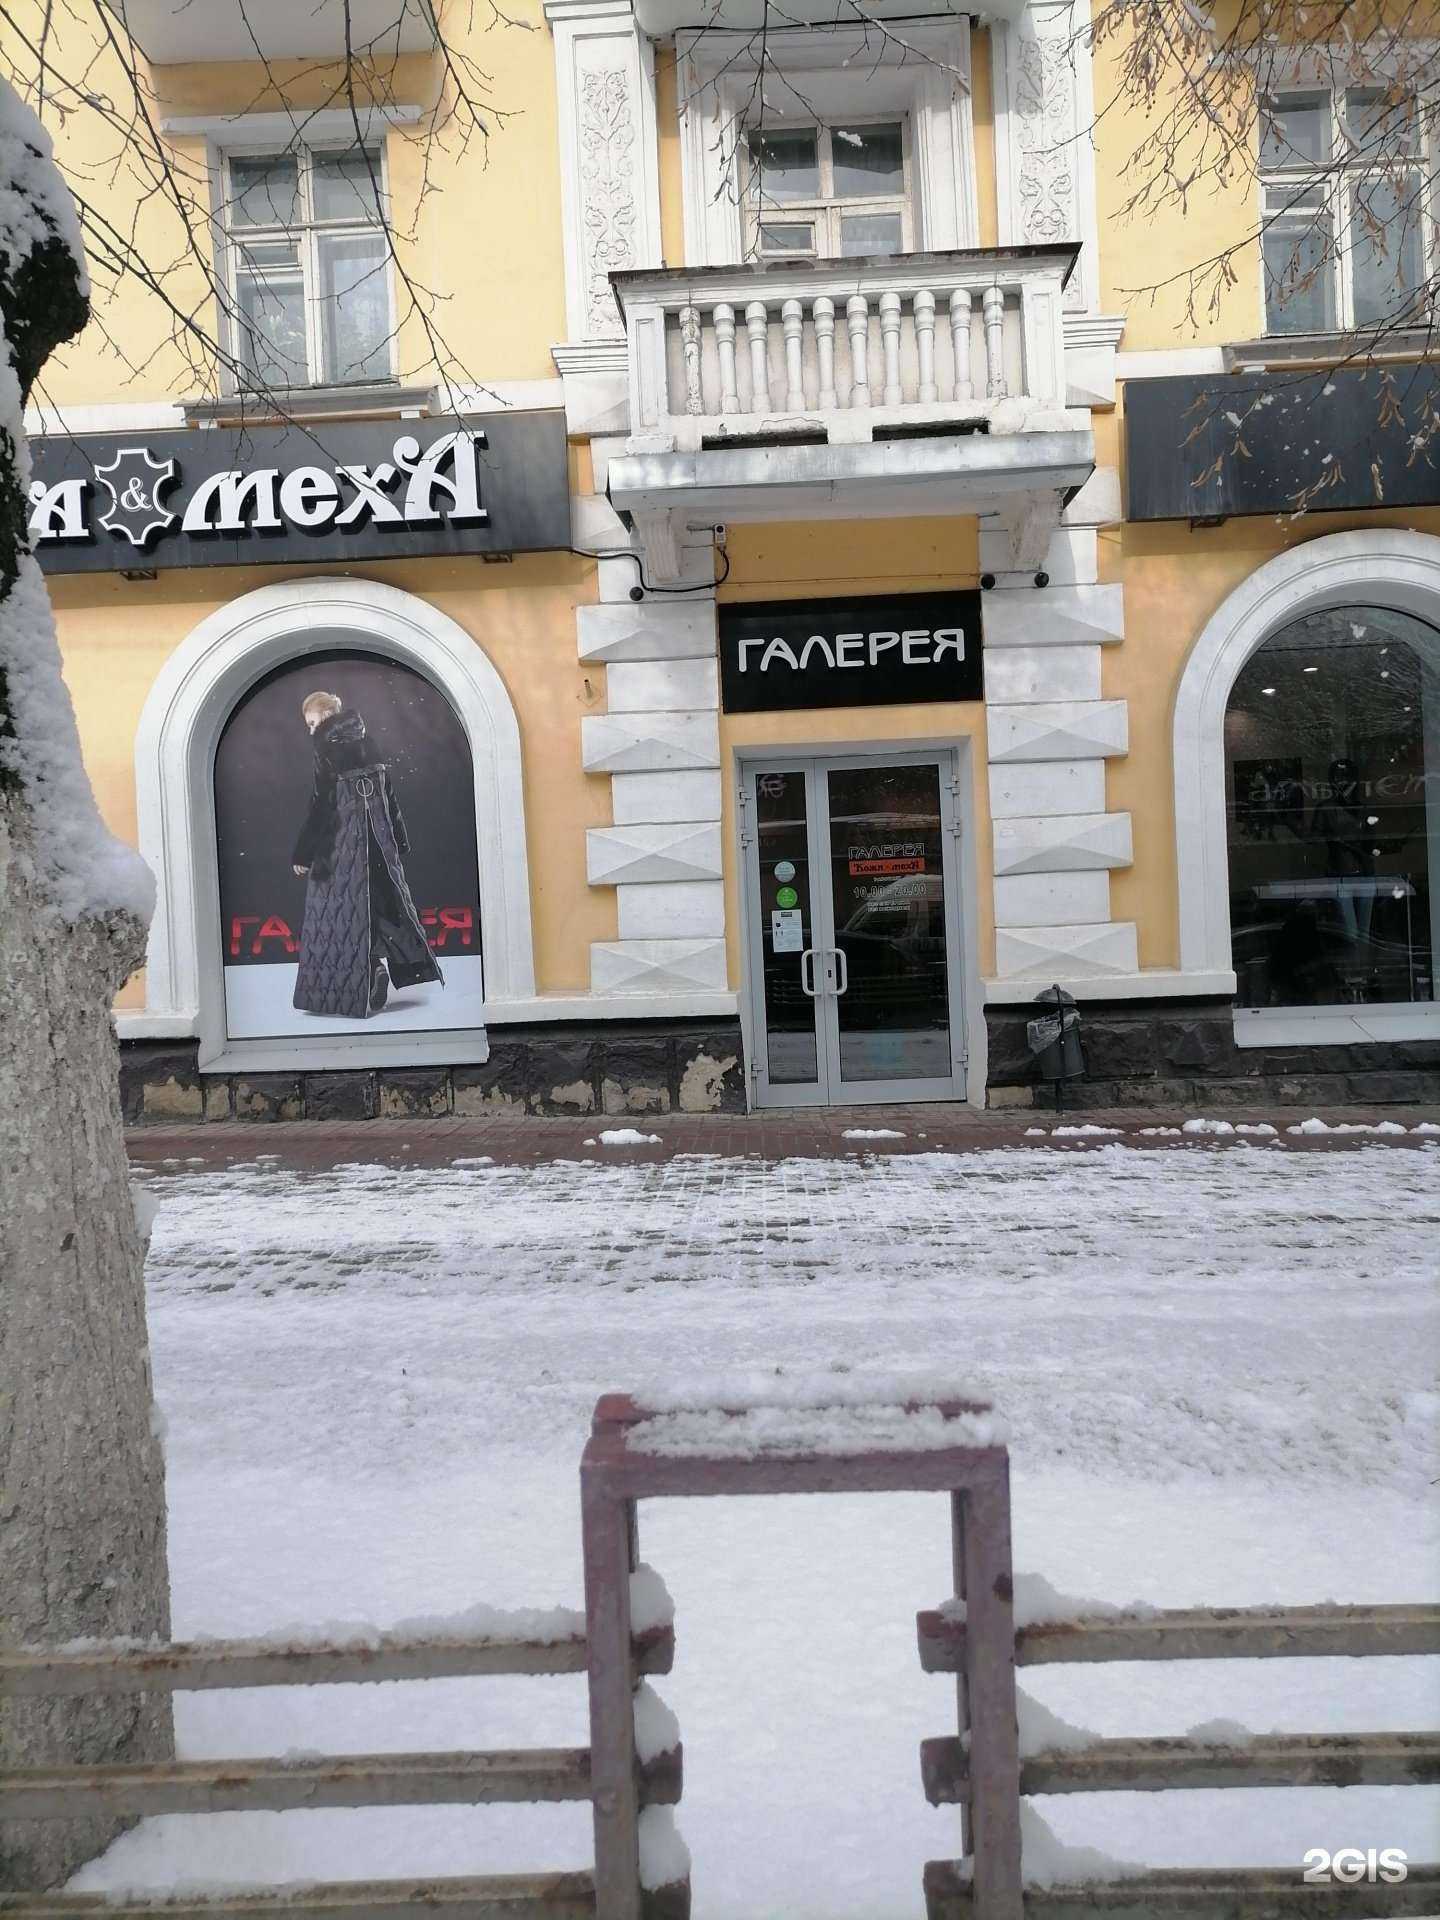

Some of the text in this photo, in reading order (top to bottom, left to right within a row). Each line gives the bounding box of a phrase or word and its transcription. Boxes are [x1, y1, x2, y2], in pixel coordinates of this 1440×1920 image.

[120, 477, 154, 512] &
[738, 628, 965, 673] ГАЛЕРЕЯ
[848, 843, 925, 860] ГАЛЕРЕЯ
